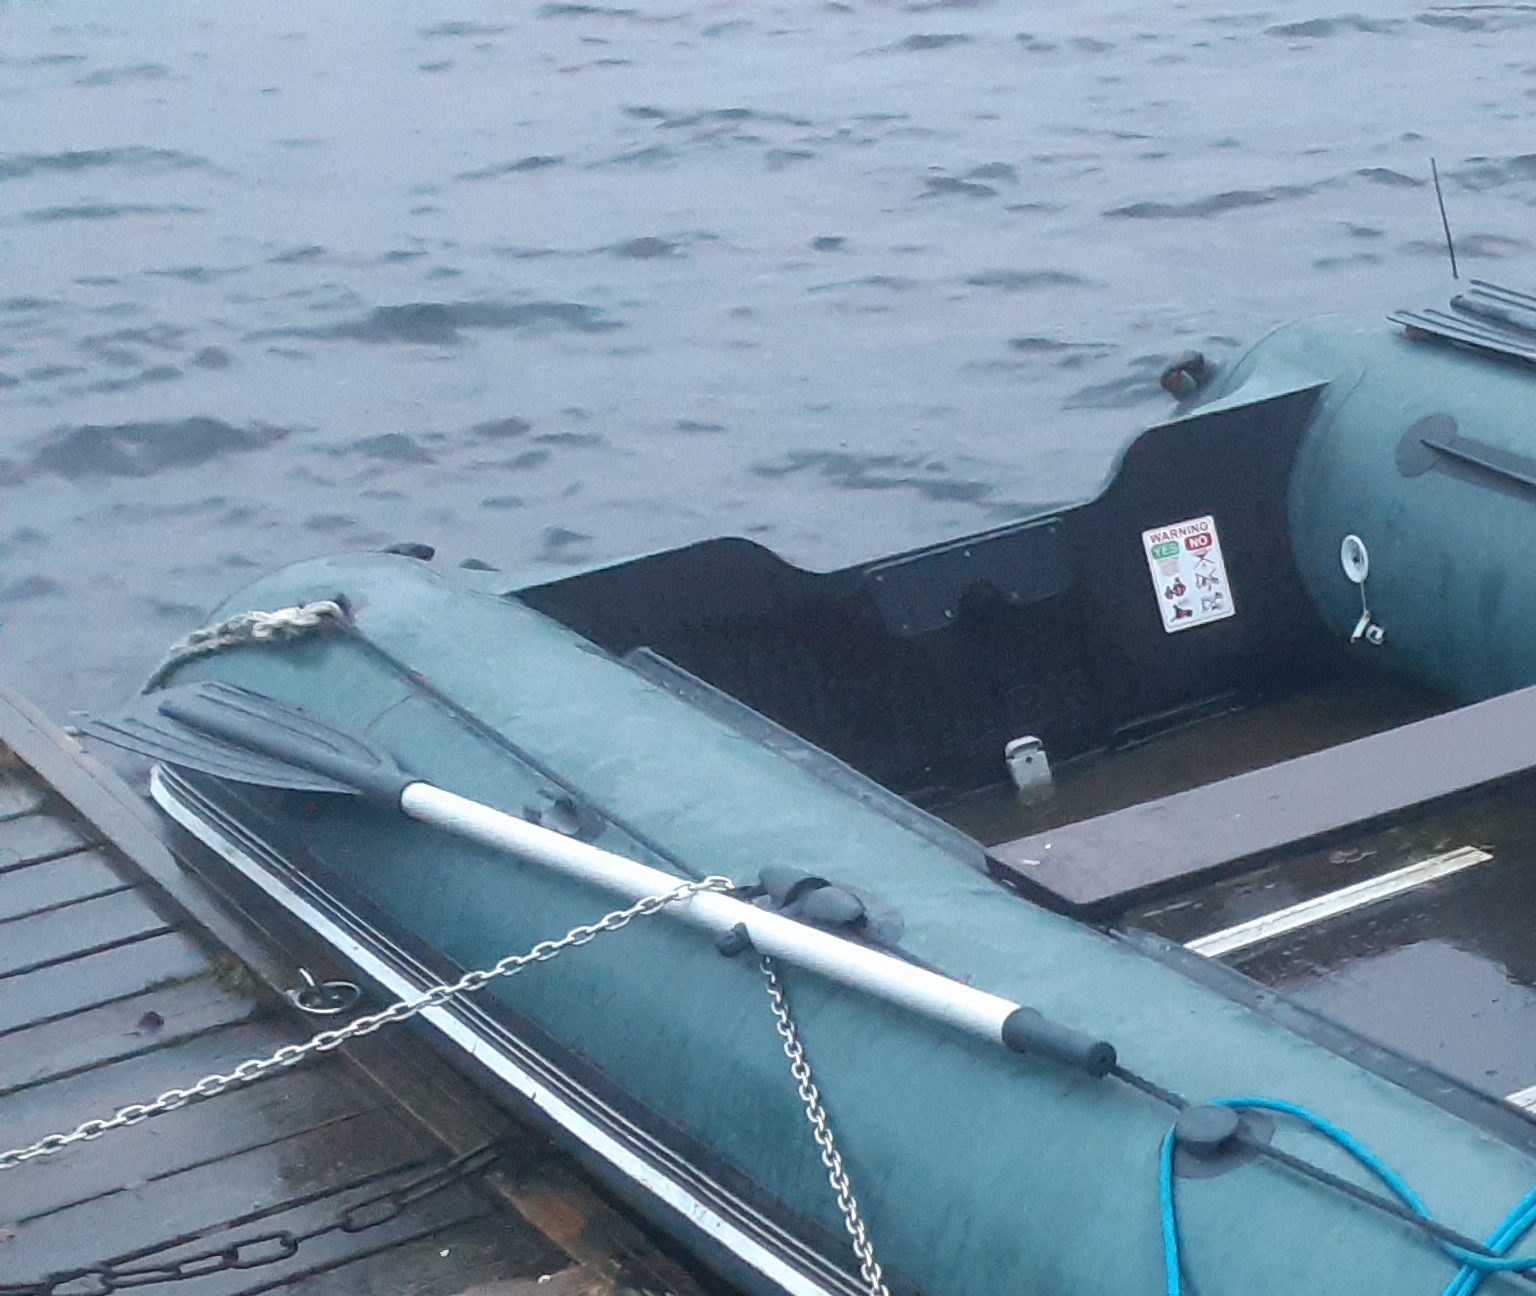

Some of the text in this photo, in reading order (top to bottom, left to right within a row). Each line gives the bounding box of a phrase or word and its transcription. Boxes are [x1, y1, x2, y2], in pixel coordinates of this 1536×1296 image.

[1150, 521, 1209, 543] WARNING
[1188, 535, 1208, 548] NO
[1152, 542, 1179, 557] YES
